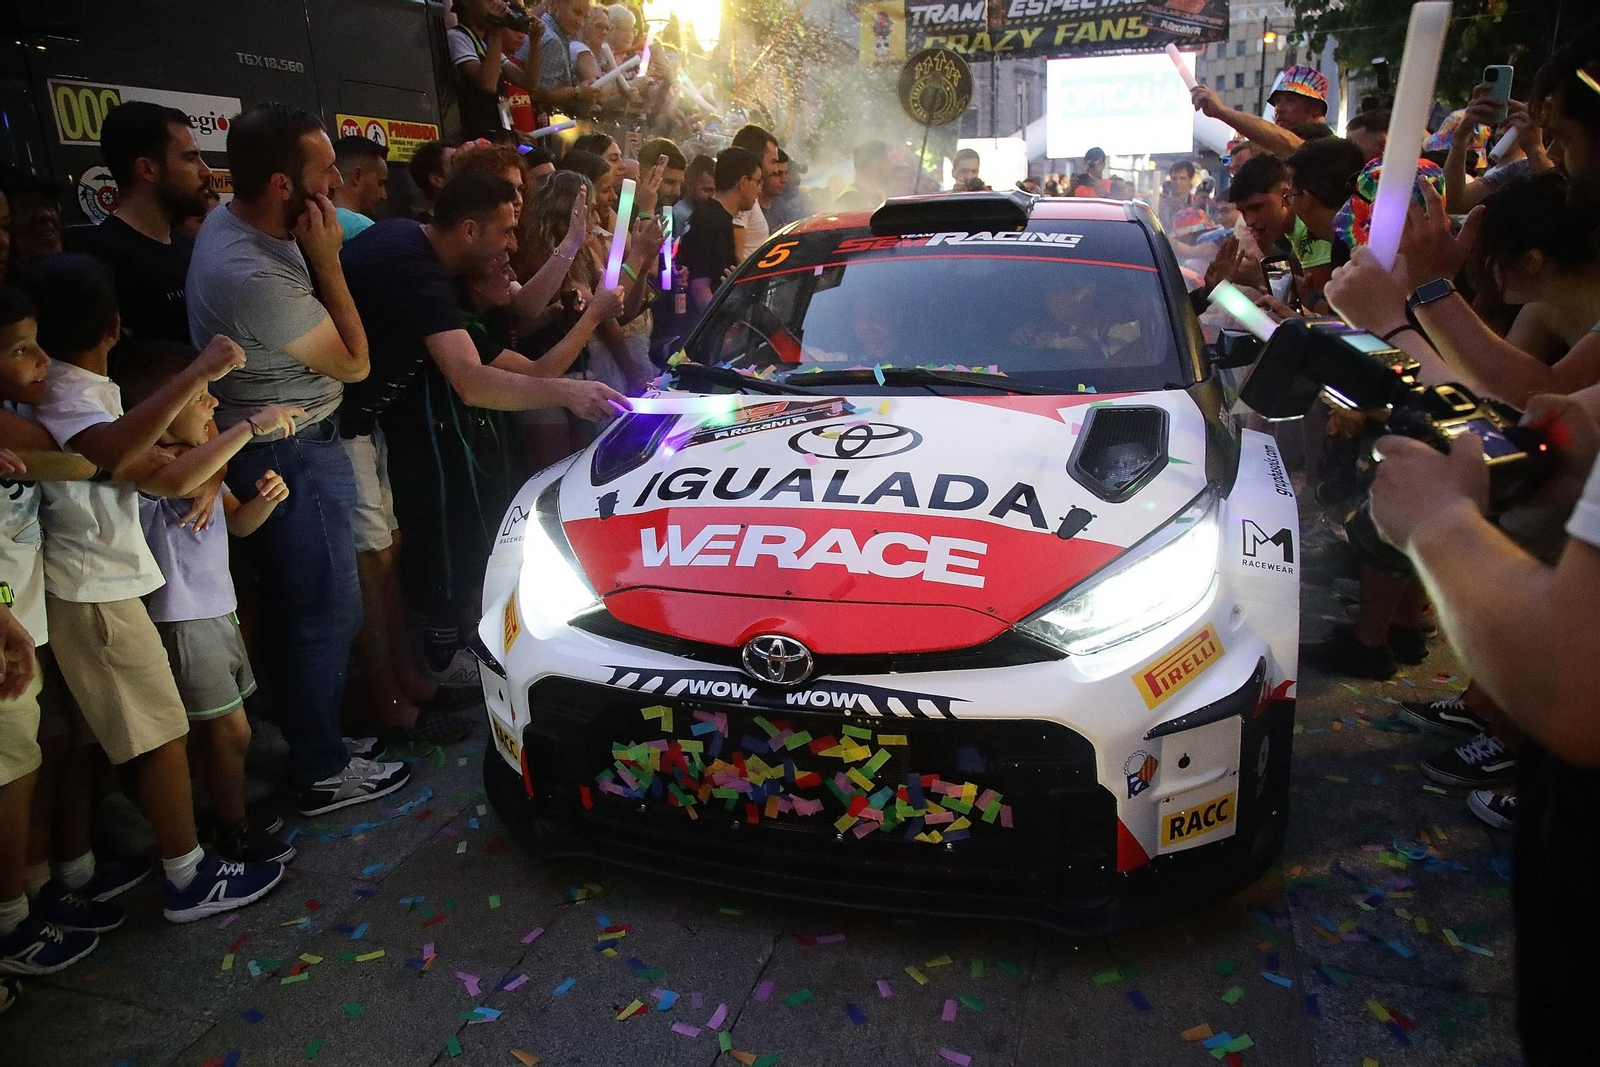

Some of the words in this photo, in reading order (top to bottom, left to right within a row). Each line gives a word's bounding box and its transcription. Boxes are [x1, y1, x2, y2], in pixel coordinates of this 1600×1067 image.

[909, 2, 986, 25] TRAM
[1053, 16, 1150, 46] FANS
[235, 51, 262, 67] TGX
[263, 57, 304, 73] 18.560
[387, 121, 437, 141] PROHIBIDO
[924, 231, 1084, 249] RACING
[757, 240, 800, 269] 5
[729, 416, 792, 437] Recalvi
[633, 466, 1049, 530] IGUALADA
[1241, 559, 1294, 574] RACEWEAR
[1144, 629, 1217, 699] PIRELLI
[688, 678, 757, 699] WOW
[786, 689, 860, 709] WOW
[1169, 798, 1229, 841] RACC
